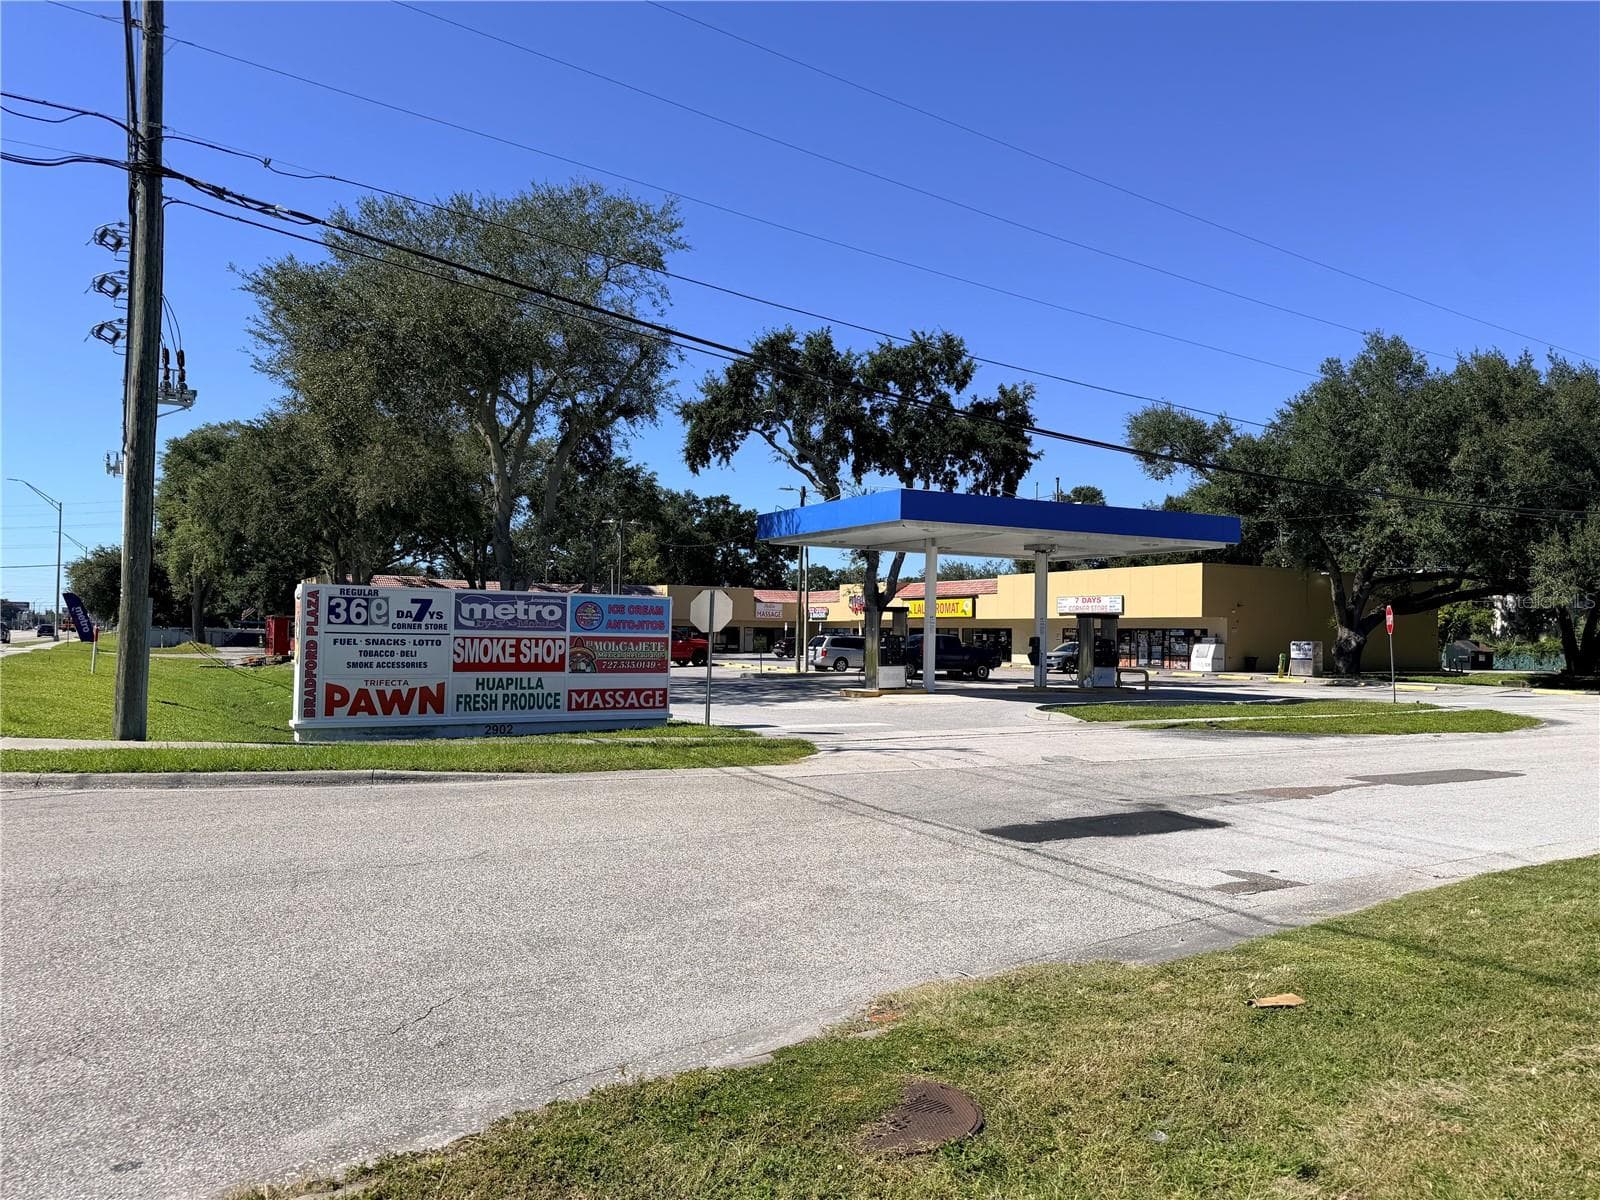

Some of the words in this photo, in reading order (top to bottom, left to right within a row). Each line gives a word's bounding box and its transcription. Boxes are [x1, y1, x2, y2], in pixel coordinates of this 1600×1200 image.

[339, 588, 379, 597] REGULAR
[306, 589, 320, 636] PLAZA
[460, 600, 562, 621] metro
[628, 605, 664, 616] CREAM
[75, 606, 90, 632] metro
[606, 619, 665, 630] ANTOJITOS
[391, 623, 423, 631] CORNER
[425, 623, 448, 631] STORE
[333, 638, 358, 646] FUEL
[365, 638, 406, 646] SNACKS
[413, 639, 442, 647] LOTTO
[594, 641, 665, 651] MOLCAJETE
[359, 650, 395, 658] TOBACCO
[400, 650, 417, 658] DELI
[453, 638, 516, 664] SMOKE
[520, 638, 565, 664] SHOP
[346, 661, 374, 669] SMOKE
[376, 661, 428, 669] ACCESSORIES
[303, 640, 318, 718] BRADFORD
[475, 677, 544, 690] HUAPILLA
[324, 682, 446, 717] PAWN
[456, 694, 498, 712] FRESH
[502, 692, 561, 711] PRODUCE
[571, 690, 665, 709] MASSAGE
[484, 724, 513, 735] 2902
